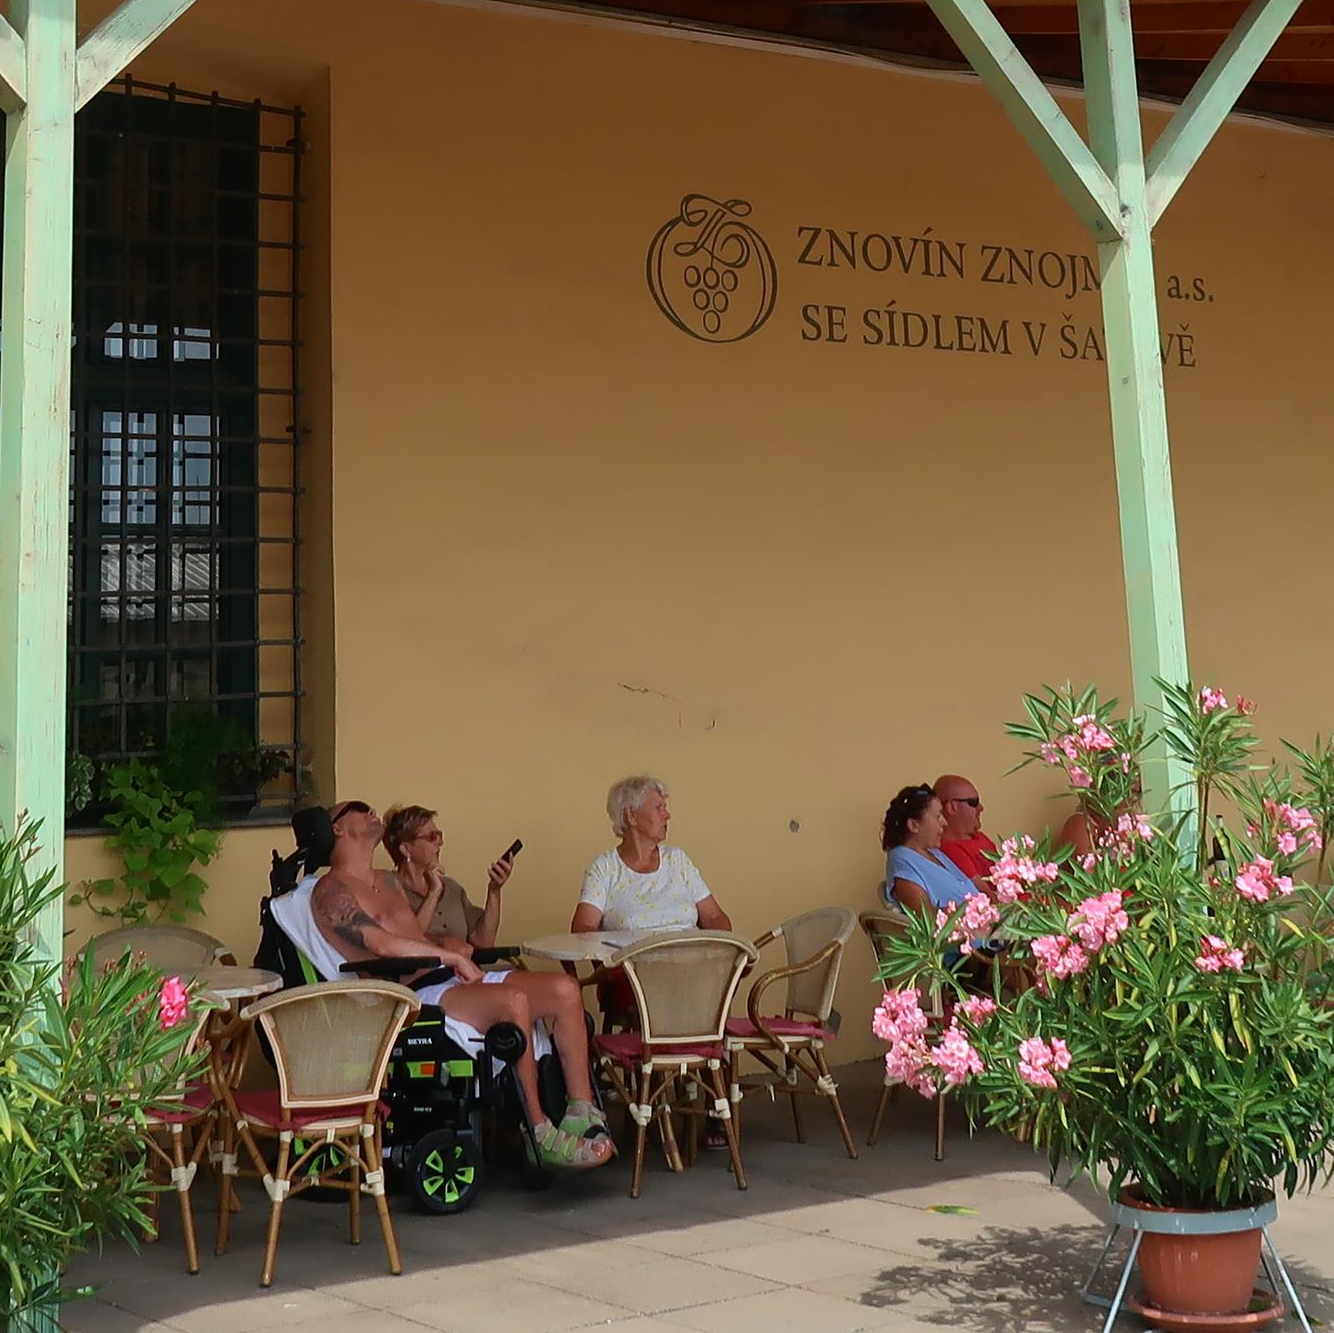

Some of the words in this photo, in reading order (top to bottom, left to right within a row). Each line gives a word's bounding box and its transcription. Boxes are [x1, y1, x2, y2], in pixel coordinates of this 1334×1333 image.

[795, 226, 967, 280] ZNOVÍN
[979, 244, 1101, 300] ZNOJM
[1166, 274, 1215, 303] a.s.
[800, 303, 849, 344] SE
[861, 298, 1012, 356] SÍDLEM
[1021, 321, 1047, 357] V
[1059, 312, 1197, 368] ŠAVĚ
